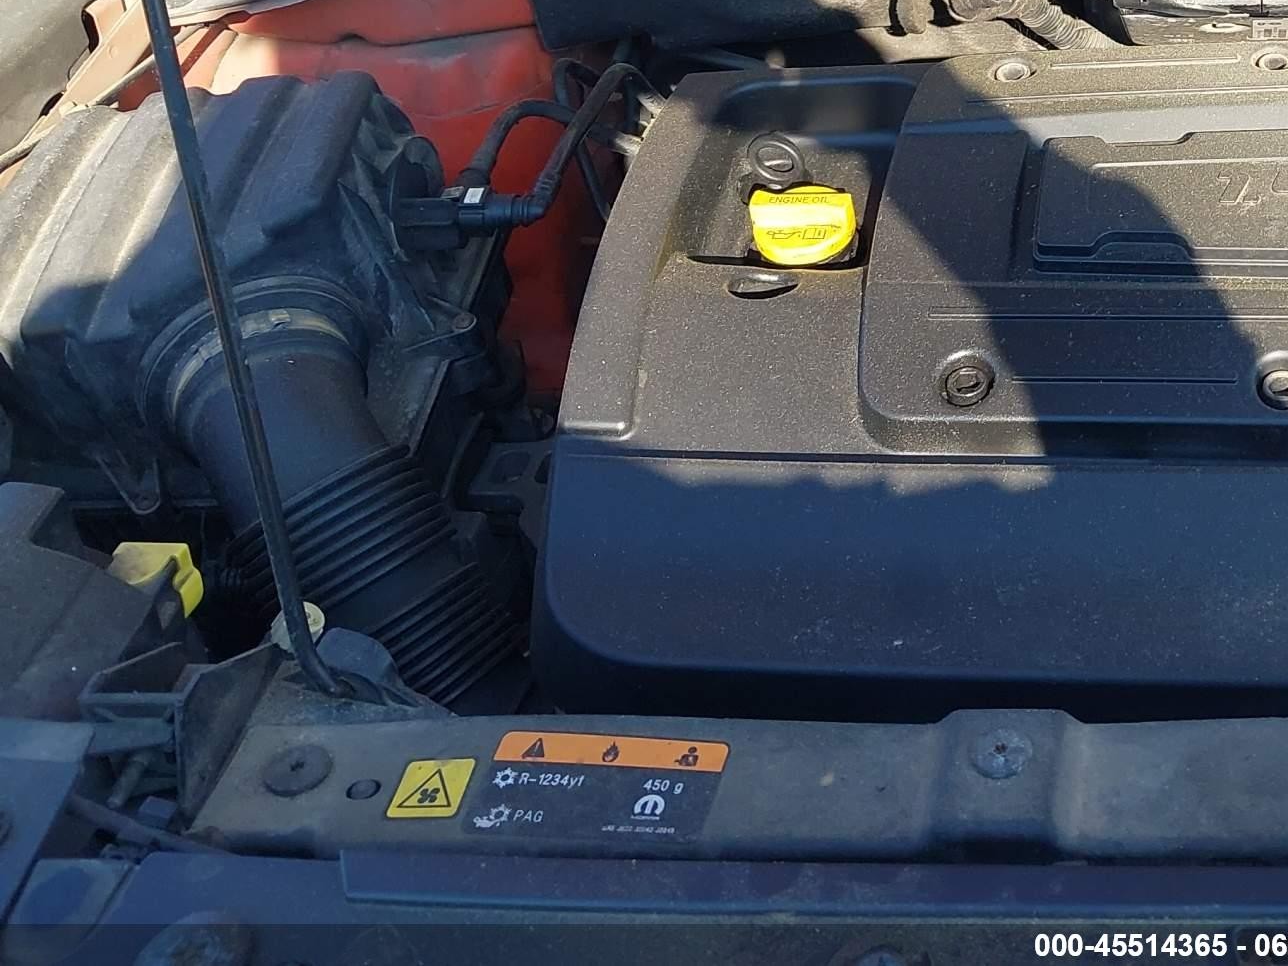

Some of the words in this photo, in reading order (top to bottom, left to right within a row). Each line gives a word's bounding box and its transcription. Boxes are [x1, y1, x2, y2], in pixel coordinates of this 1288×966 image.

[768, 196, 809, 204] ENGINE
[811, 196, 830, 204] OIL
[518, 772, 585, 789] R-1234yf
[642, 779, 670, 792] 450
[673, 782, 684, 794] g
[512, 809, 544, 823] PAG
